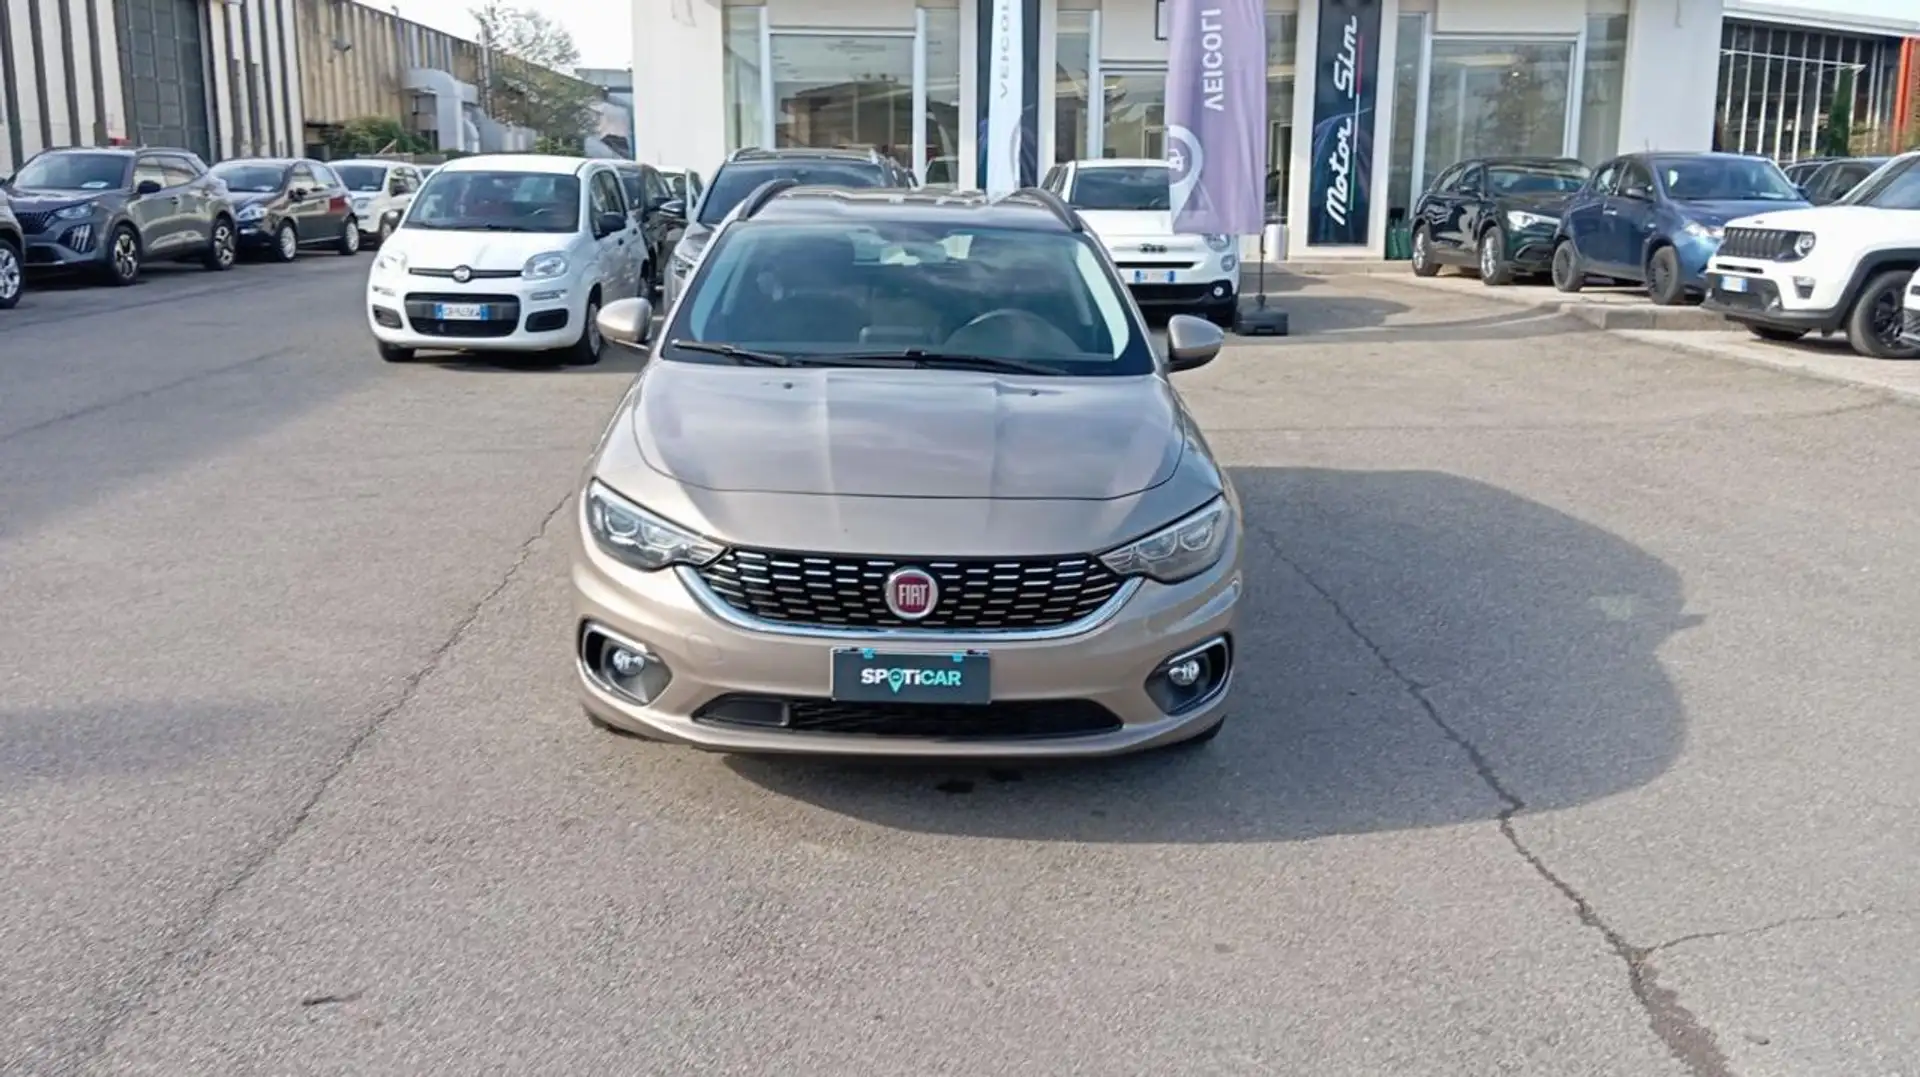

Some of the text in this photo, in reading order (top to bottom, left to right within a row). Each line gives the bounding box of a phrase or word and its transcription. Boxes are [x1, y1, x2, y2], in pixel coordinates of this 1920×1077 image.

[1326, 16, 1358, 225] Motor Sim
[898, 584, 928, 606] FIAT
